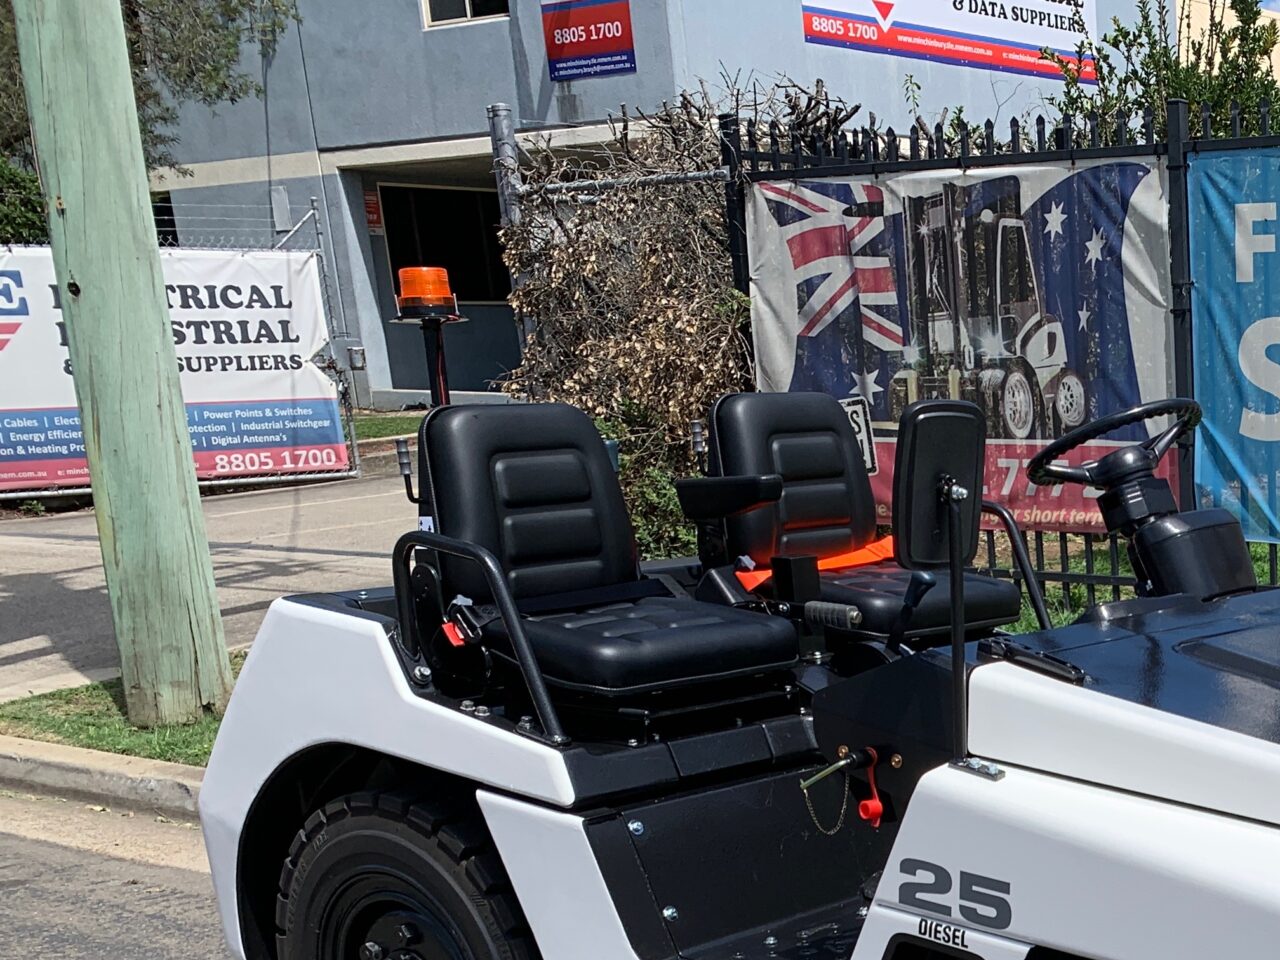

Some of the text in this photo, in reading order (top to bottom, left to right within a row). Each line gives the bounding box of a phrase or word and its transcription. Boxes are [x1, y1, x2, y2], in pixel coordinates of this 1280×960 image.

[968, 0, 1008, 20] DATA
[554, 21, 622, 45] 8805 1700
[812, 17, 845, 35] 8805
[847, 23, 878, 41] 1700
[172, 319, 300, 345] STRIAL
[4, 418, 38, 428] Cables
[204, 407, 313, 420] Power Points & Switches
[240, 419, 283, 431] Industrial
[285, 418, 331, 430] Switchgear
[10, 432, 45, 442] Energy
[212, 435, 241, 447] Digital
[243, 432, 288, 444] Antenna's
[28, 444, 69, 455] Heating
[215, 449, 336, 473] 8805 1700
[1022, 505, 1066, 524] short
[898, 857, 1012, 931] 25
[918, 918, 969, 949] DIESEL
